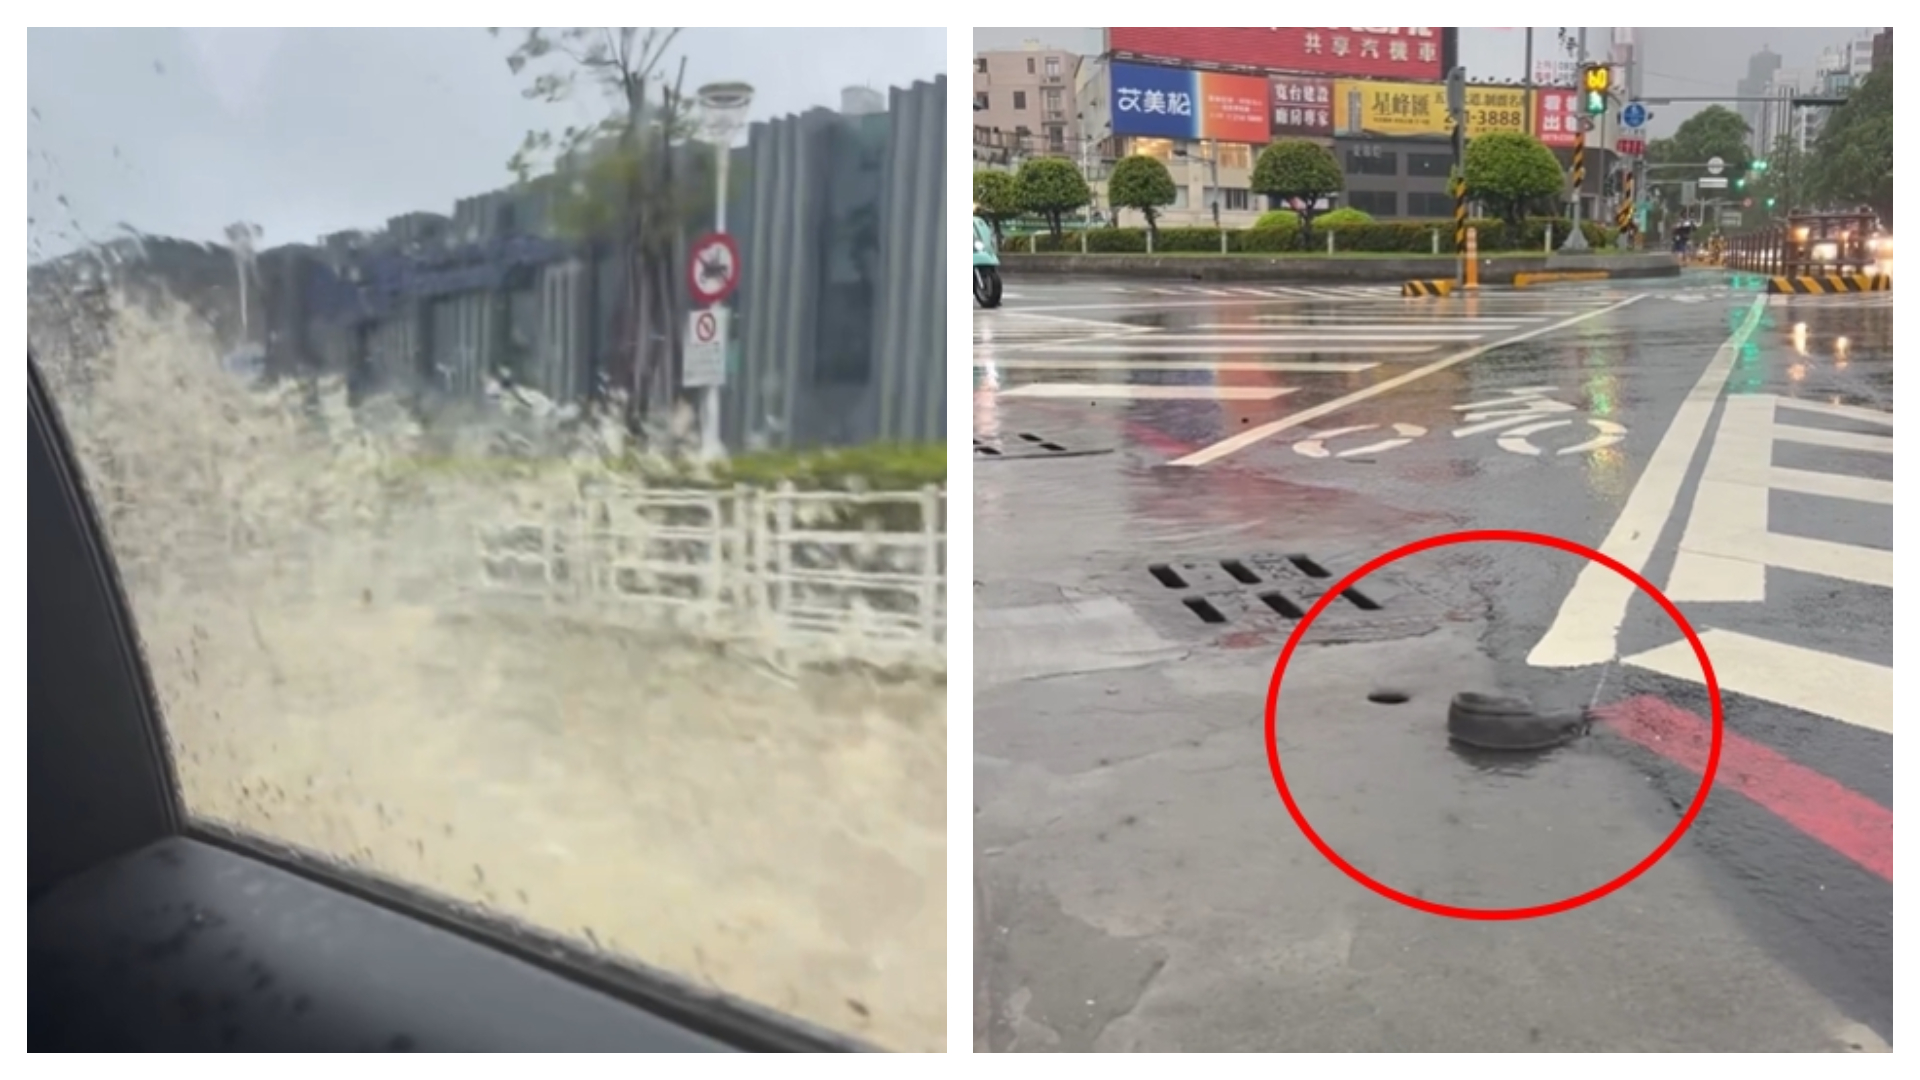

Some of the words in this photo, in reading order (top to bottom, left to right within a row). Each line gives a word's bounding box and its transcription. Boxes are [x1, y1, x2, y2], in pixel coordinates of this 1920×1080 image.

[1304, 33, 1436, 62] 共享汽機車
[1116, 87, 1191, 116] 艾美松
[1372, 91, 1430, 116] 星峰匯
[1444, 108, 1520, 126] 21-3888
